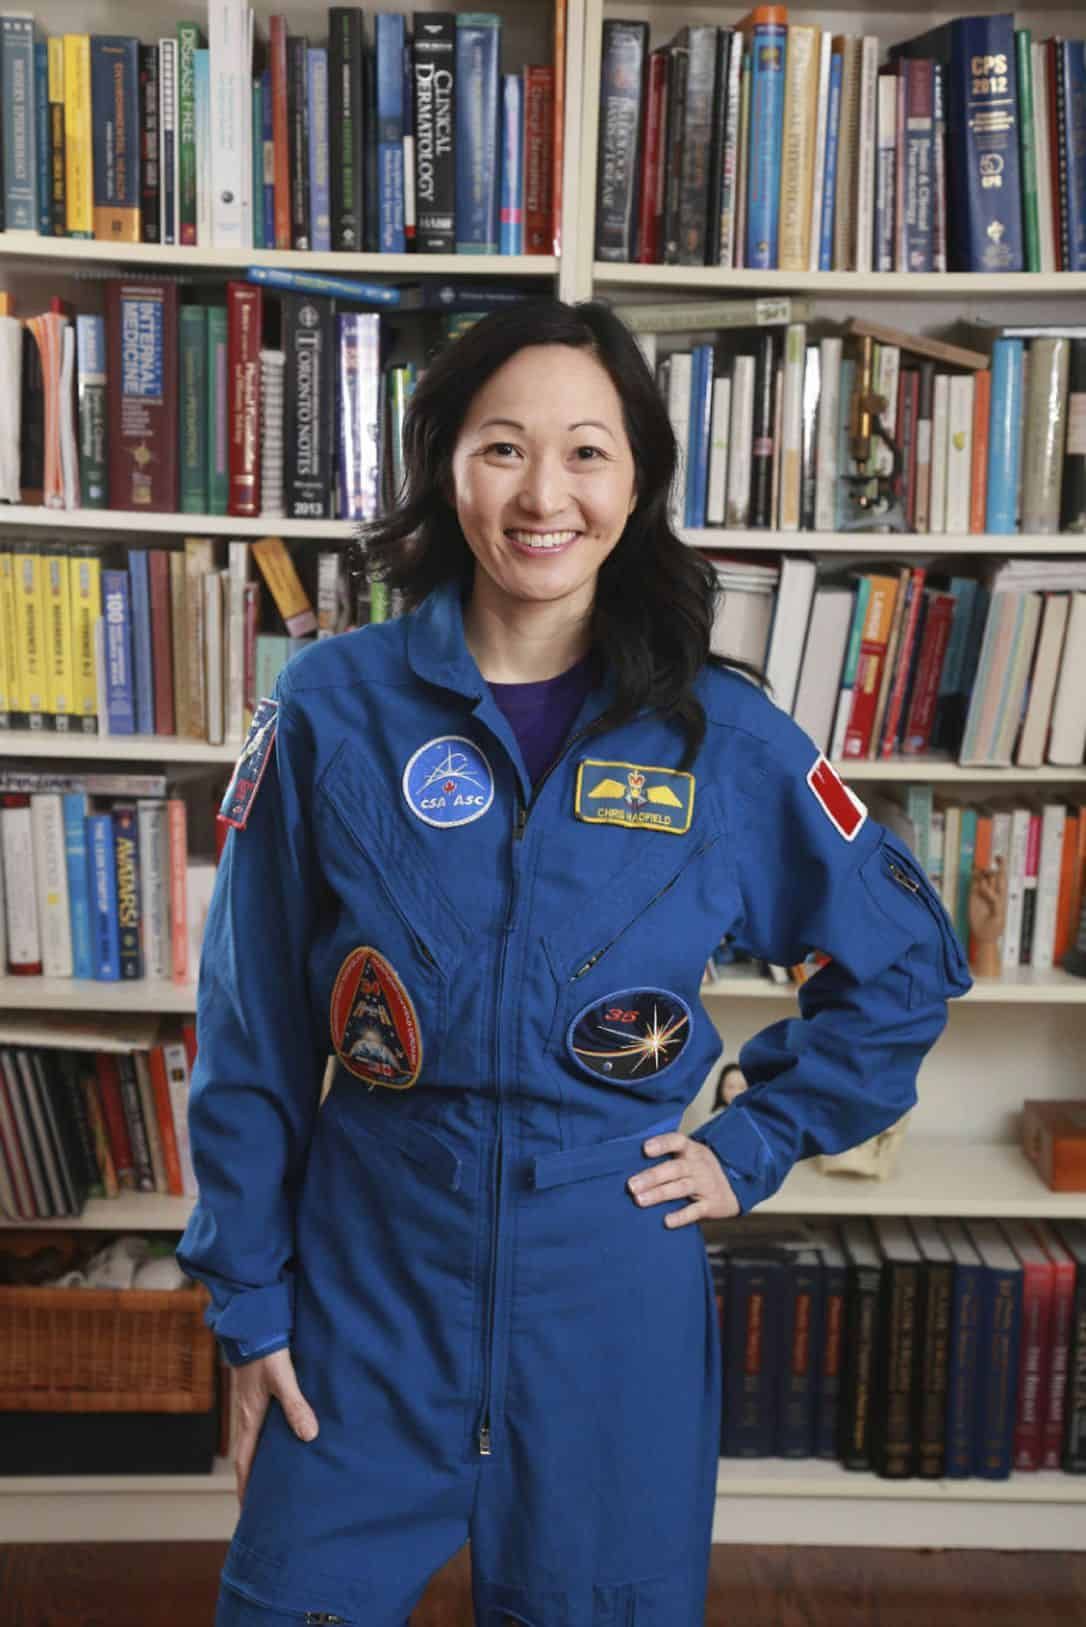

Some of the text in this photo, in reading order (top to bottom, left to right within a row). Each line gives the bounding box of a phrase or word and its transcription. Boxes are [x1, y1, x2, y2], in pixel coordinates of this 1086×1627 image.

[180, 28, 195, 97] DISEASE
[971, 54, 1008, 75] CPS
[972, 77, 1008, 94] 2012
[181, 101, 195, 144] FREE
[416, 63, 434, 202] DERMATOLOGY
[433, 69, 453, 157] CLINICAL
[123, 303, 138, 394] MEDICINE
[139, 302, 155, 394] INTERNAL
[297, 333, 319, 425] TORONTO
[297, 427, 312, 475] NOTES
[293, 502, 323, 515] 2013
[107, 592, 124, 624] 100
[420, 794, 484, 809] CSA ASC
[116, 837, 138, 928] AVATARS!
